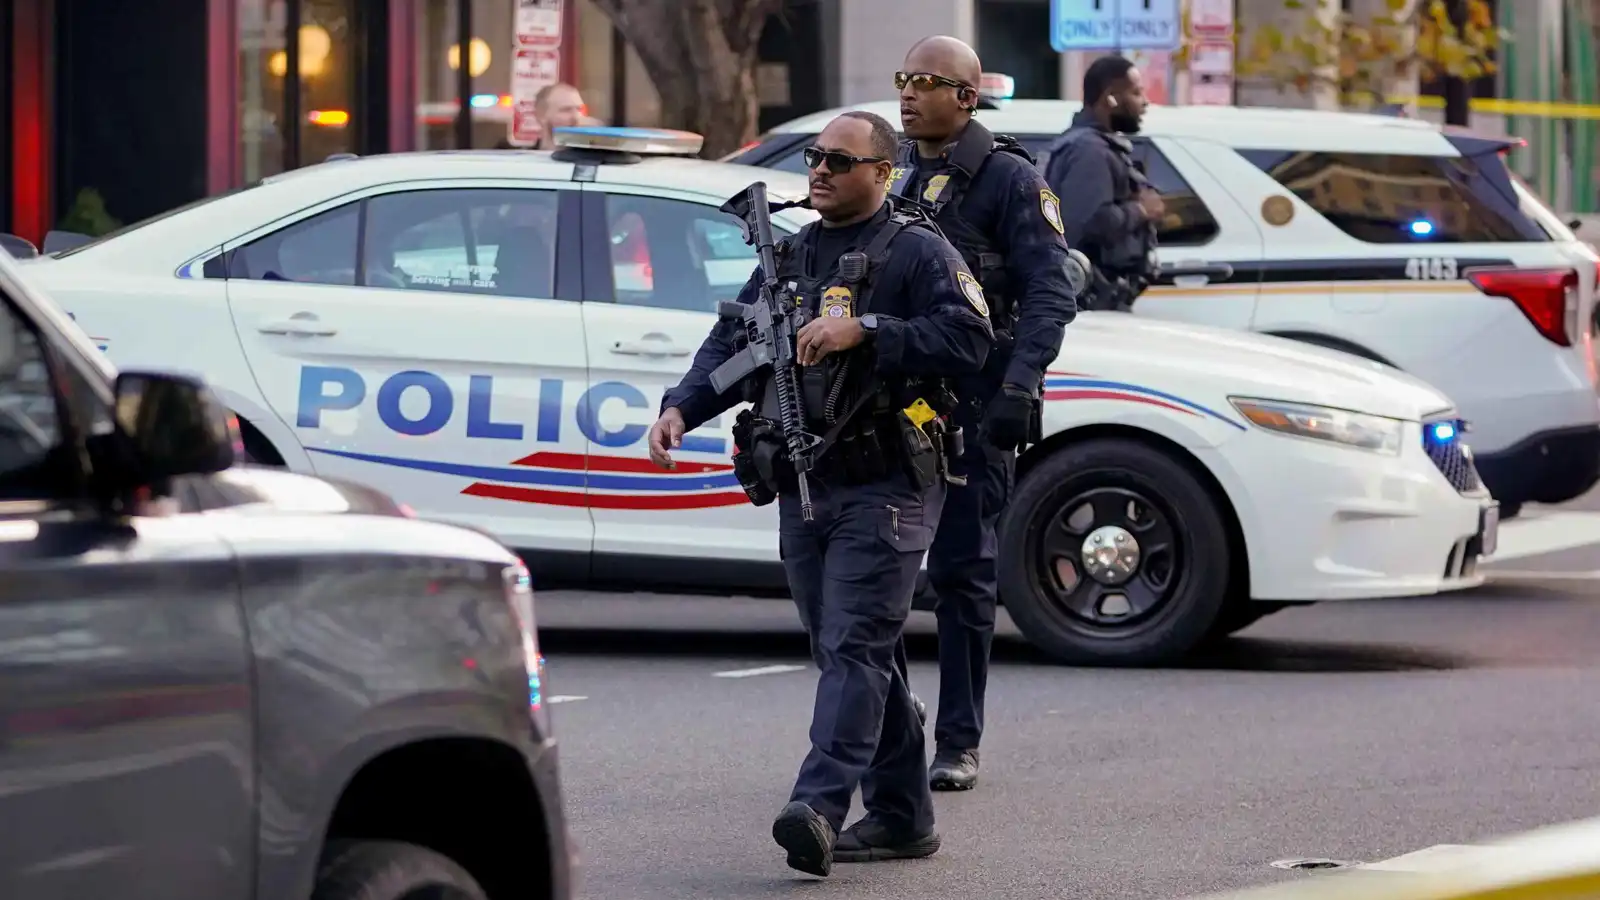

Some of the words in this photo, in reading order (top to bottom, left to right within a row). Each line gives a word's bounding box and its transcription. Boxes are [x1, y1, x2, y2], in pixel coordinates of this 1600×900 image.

[1061, 20, 1112, 39] ONLY
[1122, 19, 1172, 38] ONLY
[888, 168, 906, 179] ICE
[1404, 257, 1458, 280] 4143
